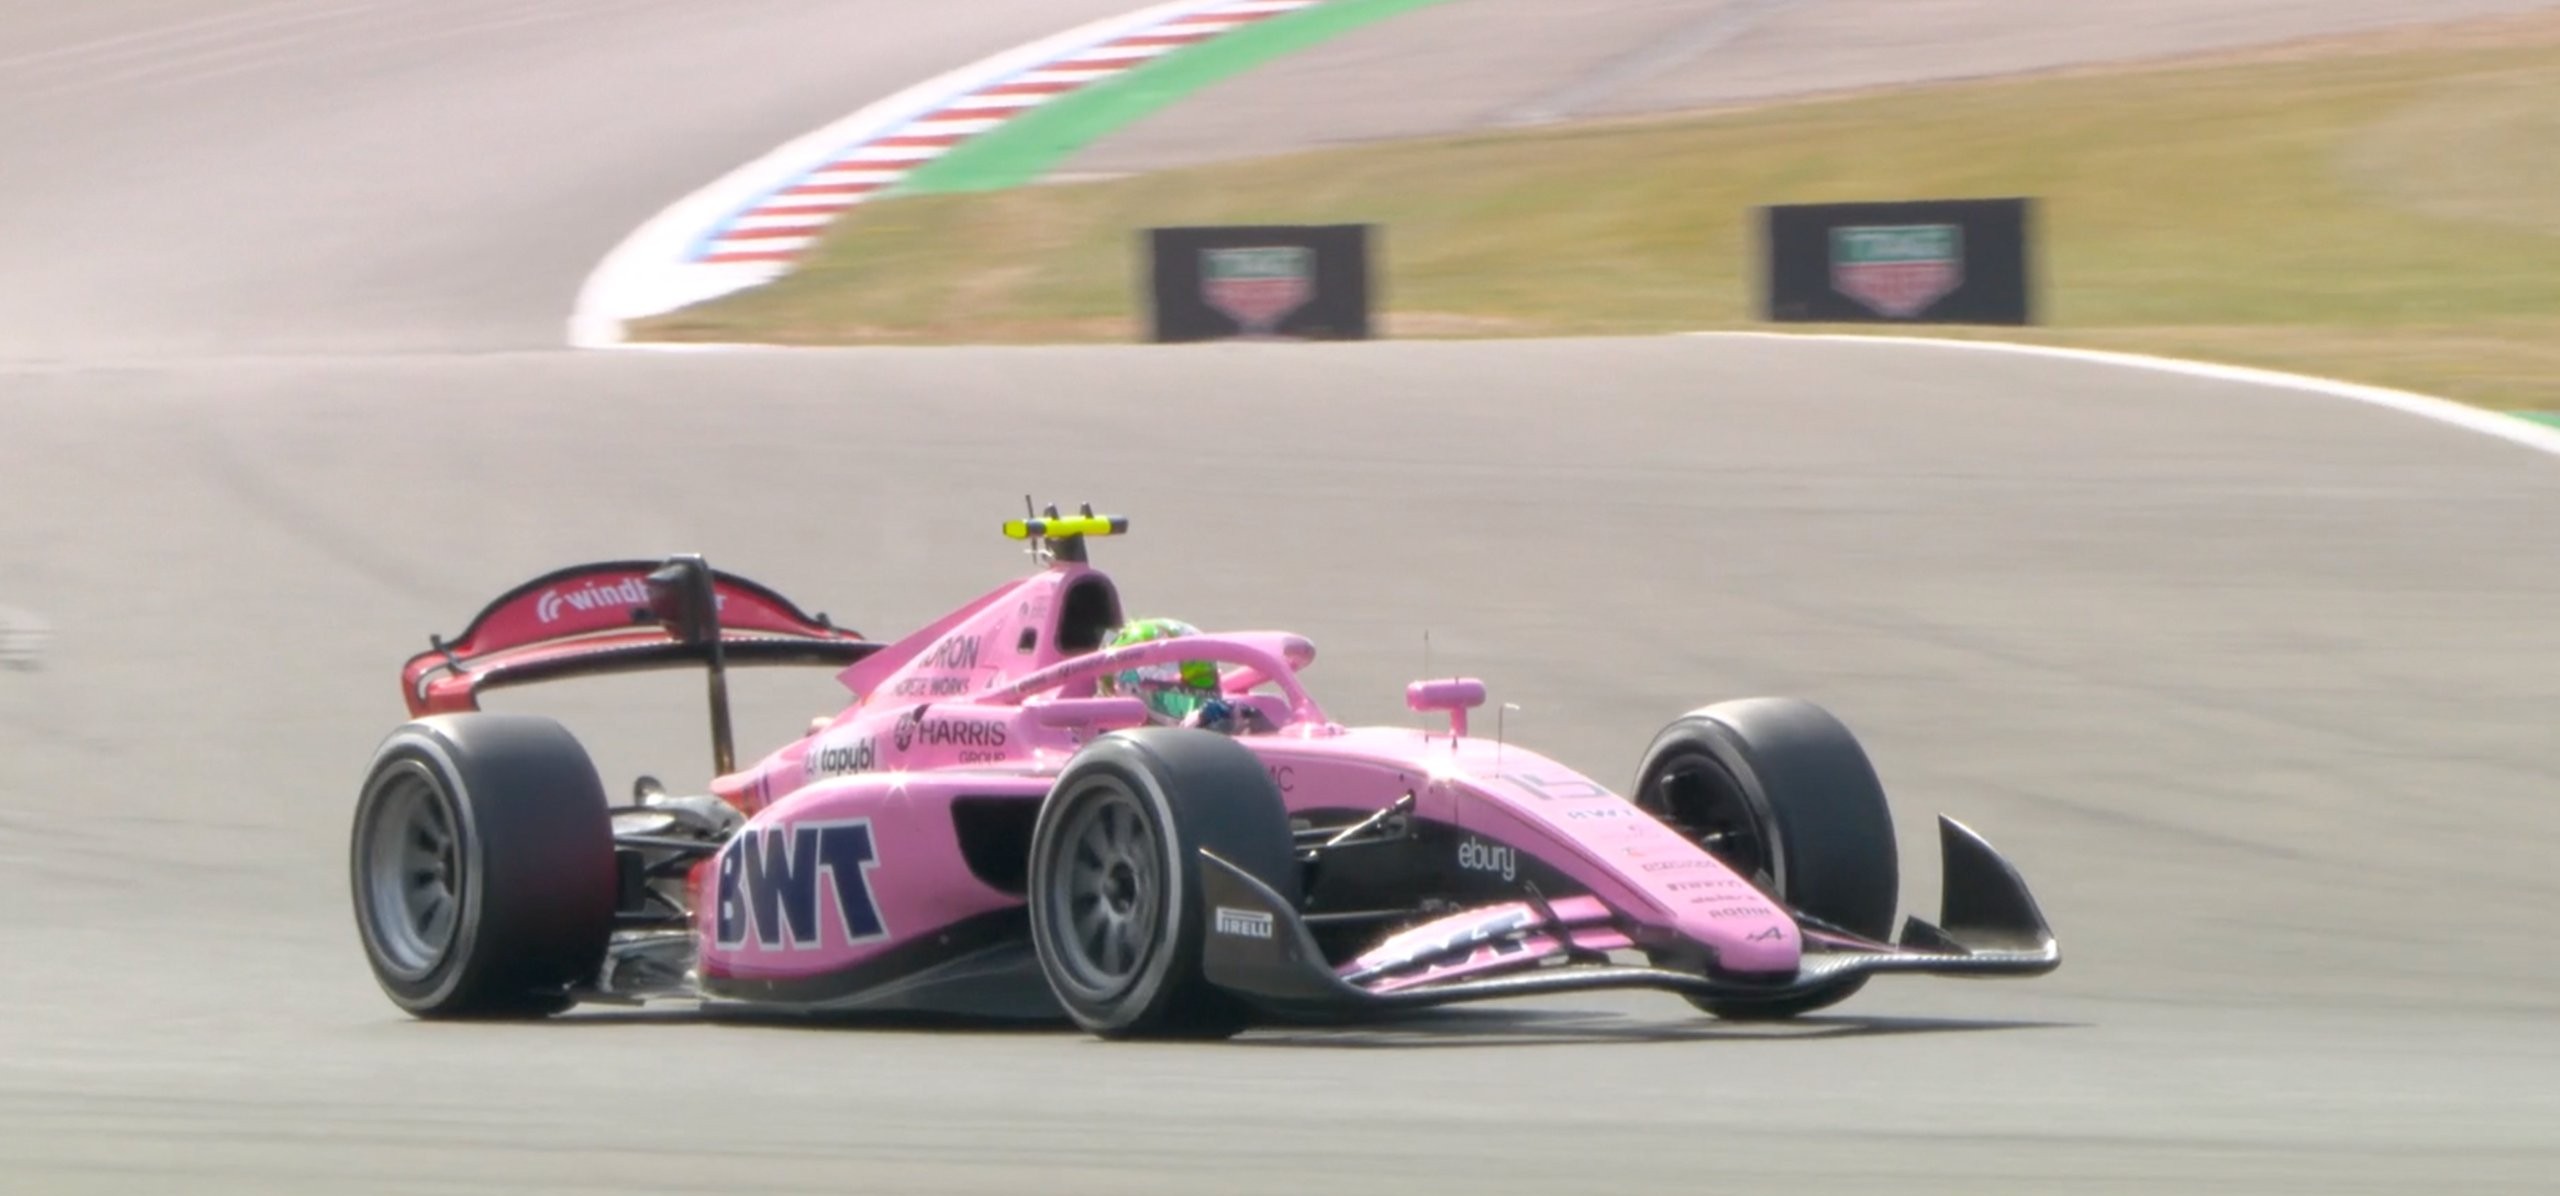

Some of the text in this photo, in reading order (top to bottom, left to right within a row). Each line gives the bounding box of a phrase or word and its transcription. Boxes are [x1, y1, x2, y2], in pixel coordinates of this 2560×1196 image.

[918, 720, 1007, 747] HARRIS
[1458, 835, 1516, 882] ebury
[715, 816, 891, 951] BWT
[1216, 906, 1273, 938] PIRELLI
